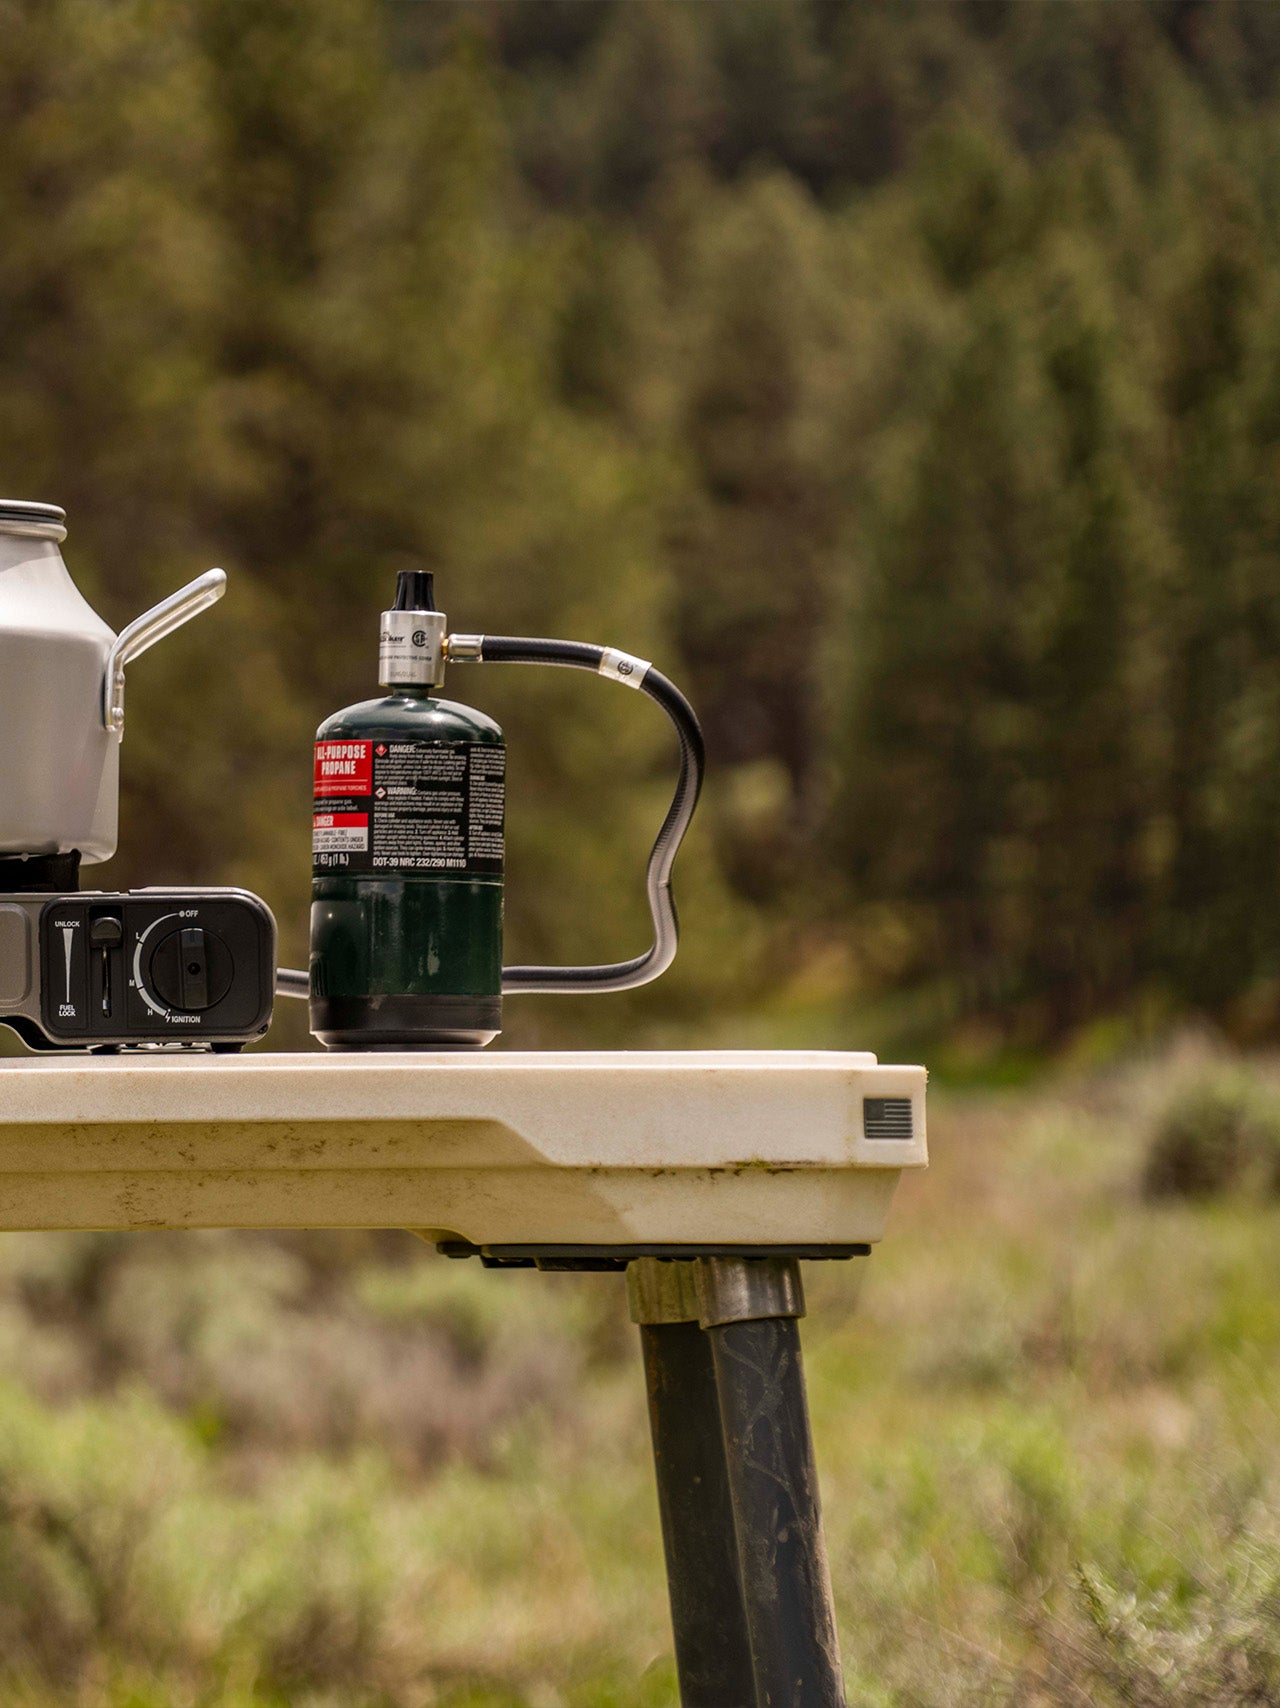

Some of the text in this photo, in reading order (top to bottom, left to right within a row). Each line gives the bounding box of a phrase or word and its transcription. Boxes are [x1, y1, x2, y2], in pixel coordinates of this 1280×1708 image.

[321, 761, 356, 776] PROPANE
[373, 856, 399, 867] DOT-39
[400, 857, 416, 867] NRC
[185, 910, 199, 918] OFF
[55, 920, 80, 928] UNLOCK
[135, 932, 140, 940] L
[128, 979, 135, 987] M
[147, 1008, 153, 1016] H
[171, 1015, 201, 1024] IGNITION
